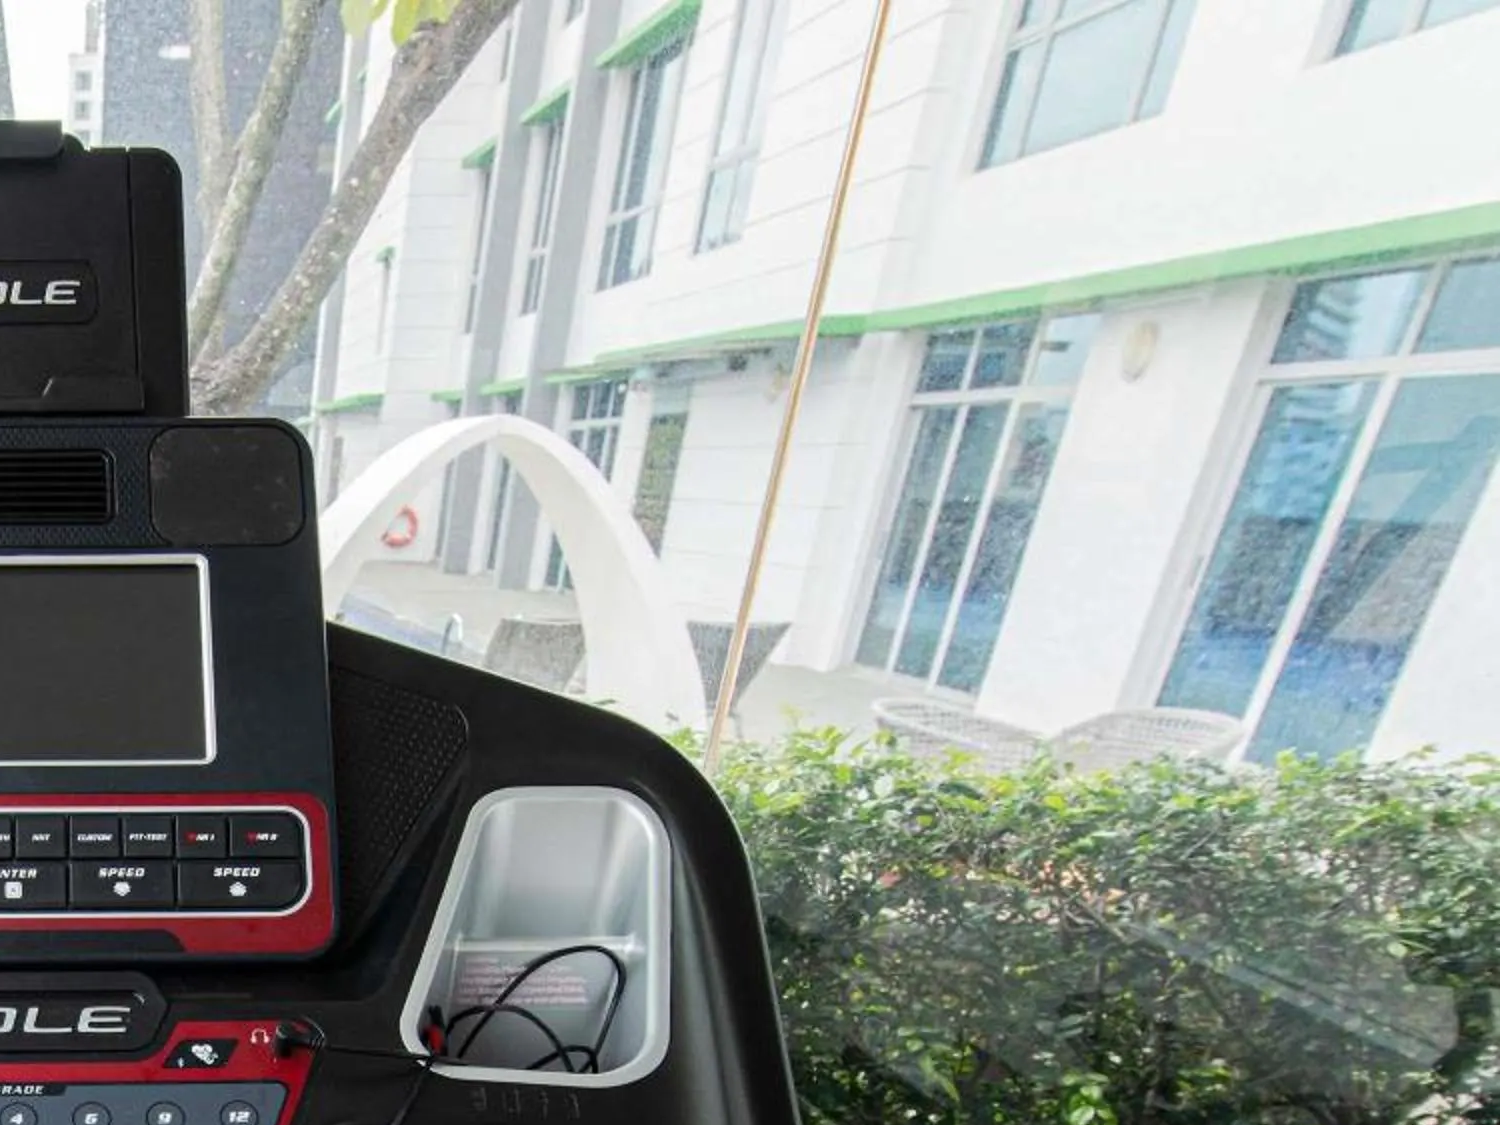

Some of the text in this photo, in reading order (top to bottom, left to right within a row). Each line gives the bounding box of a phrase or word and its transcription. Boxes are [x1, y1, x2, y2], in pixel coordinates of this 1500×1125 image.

[97, 866, 146, 879] SPEED
[212, 866, 261, 878] SPEED
[9, 1112, 24, 1125] 4
[83, 1112, 98, 1125] 6
[157, 1111, 172, 1125] 9
[228, 1110, 251, 1124] 12
